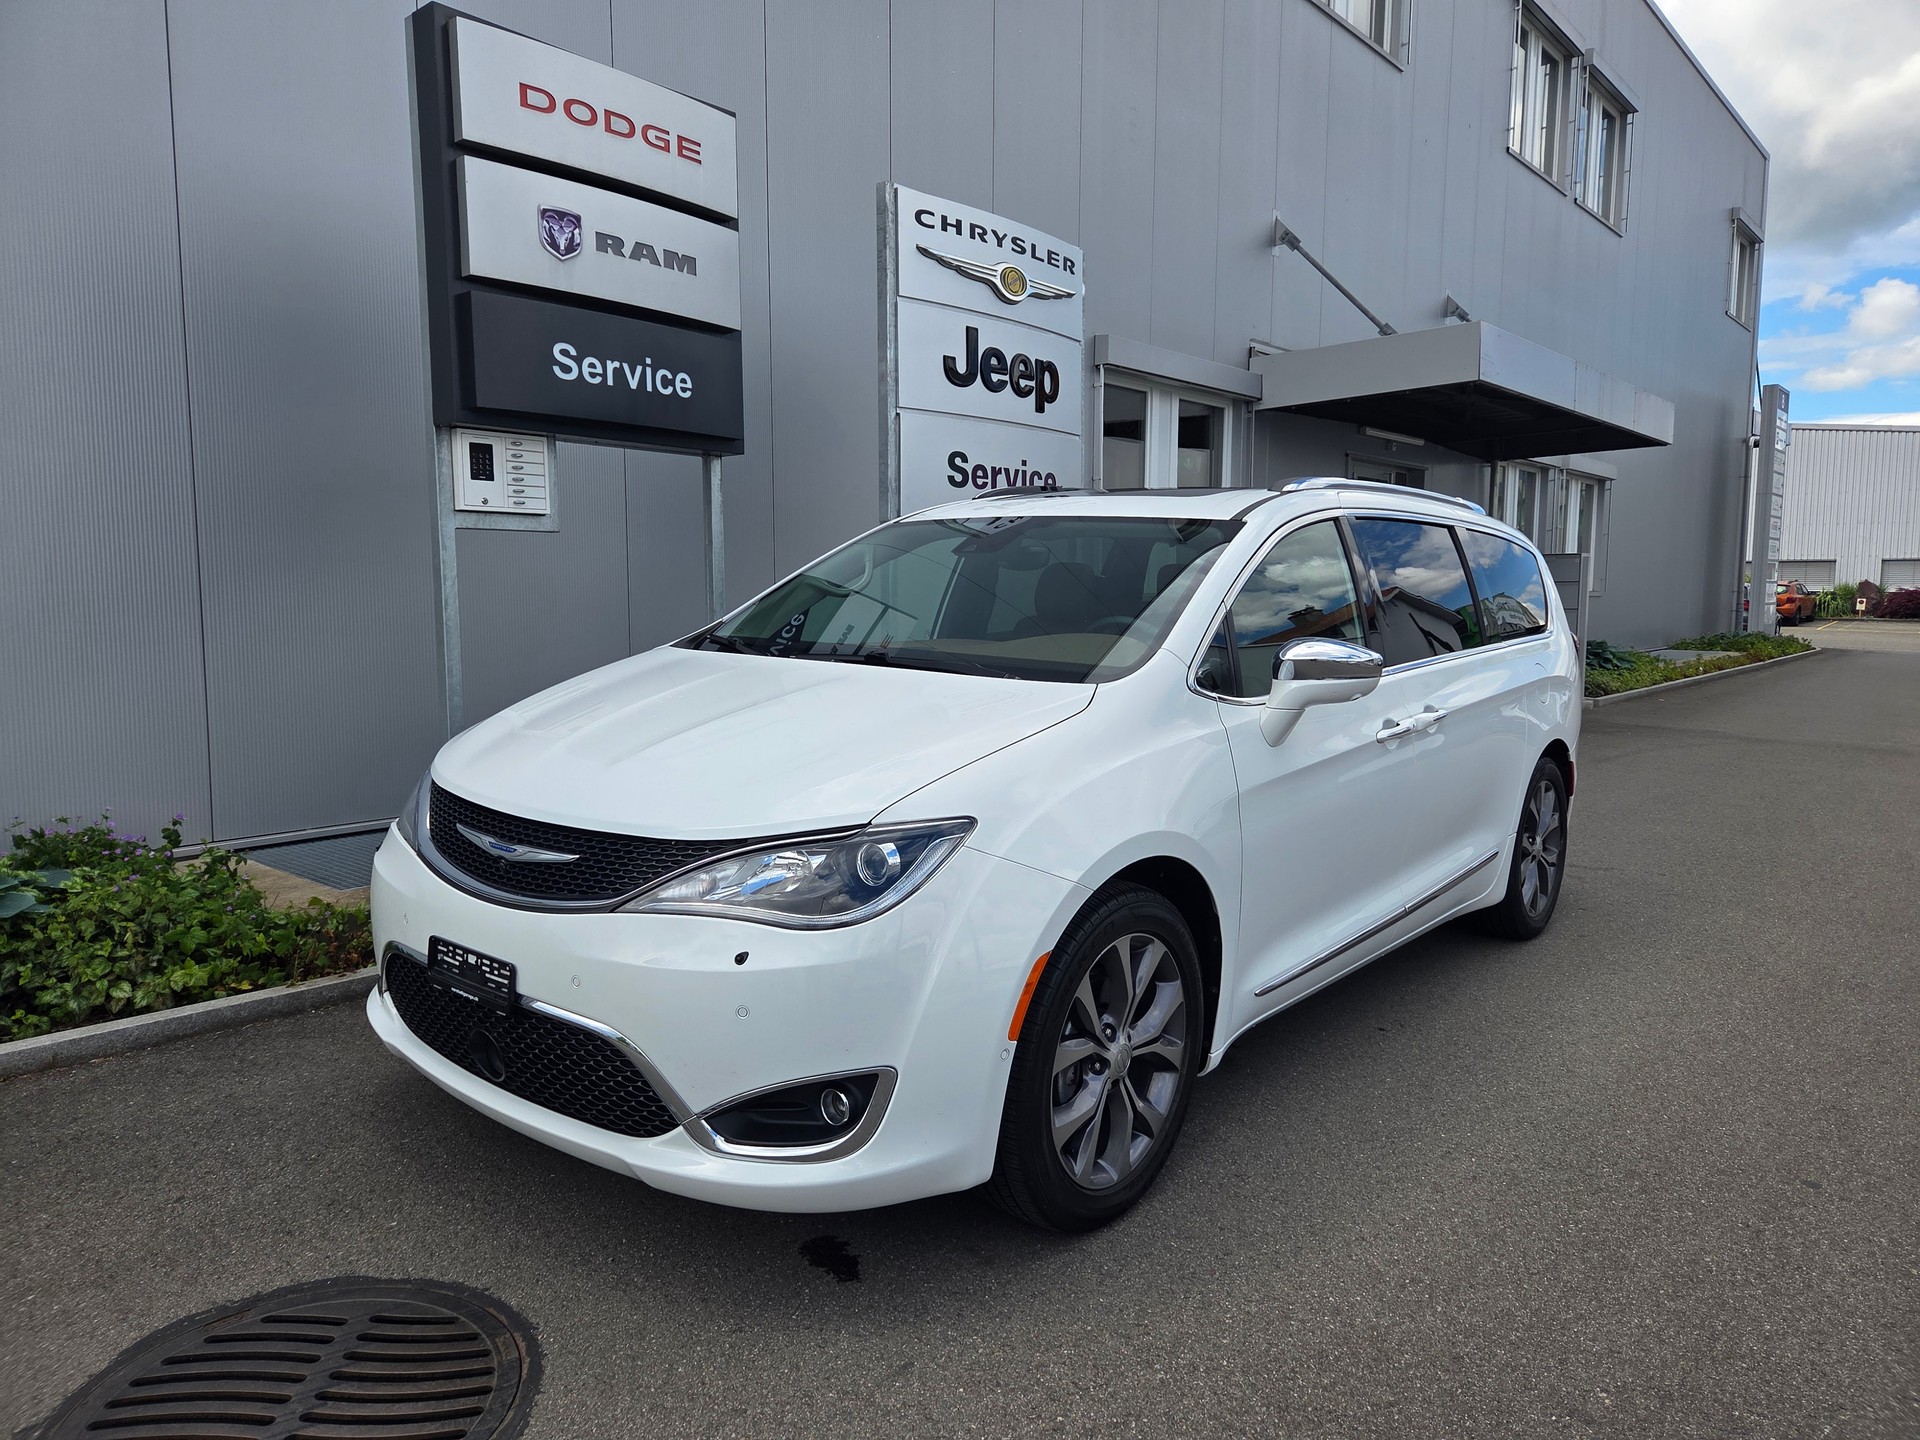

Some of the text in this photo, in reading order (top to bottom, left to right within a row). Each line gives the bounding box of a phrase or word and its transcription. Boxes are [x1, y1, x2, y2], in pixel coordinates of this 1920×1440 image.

[518, 81, 702, 165] DODGE
[595, 230, 697, 277] RAM
[914, 208, 1076, 276] CHRYSLER
[552, 341, 693, 399] Service
[943, 325, 1060, 414] Jeep
[947, 450, 1057, 490] Service
